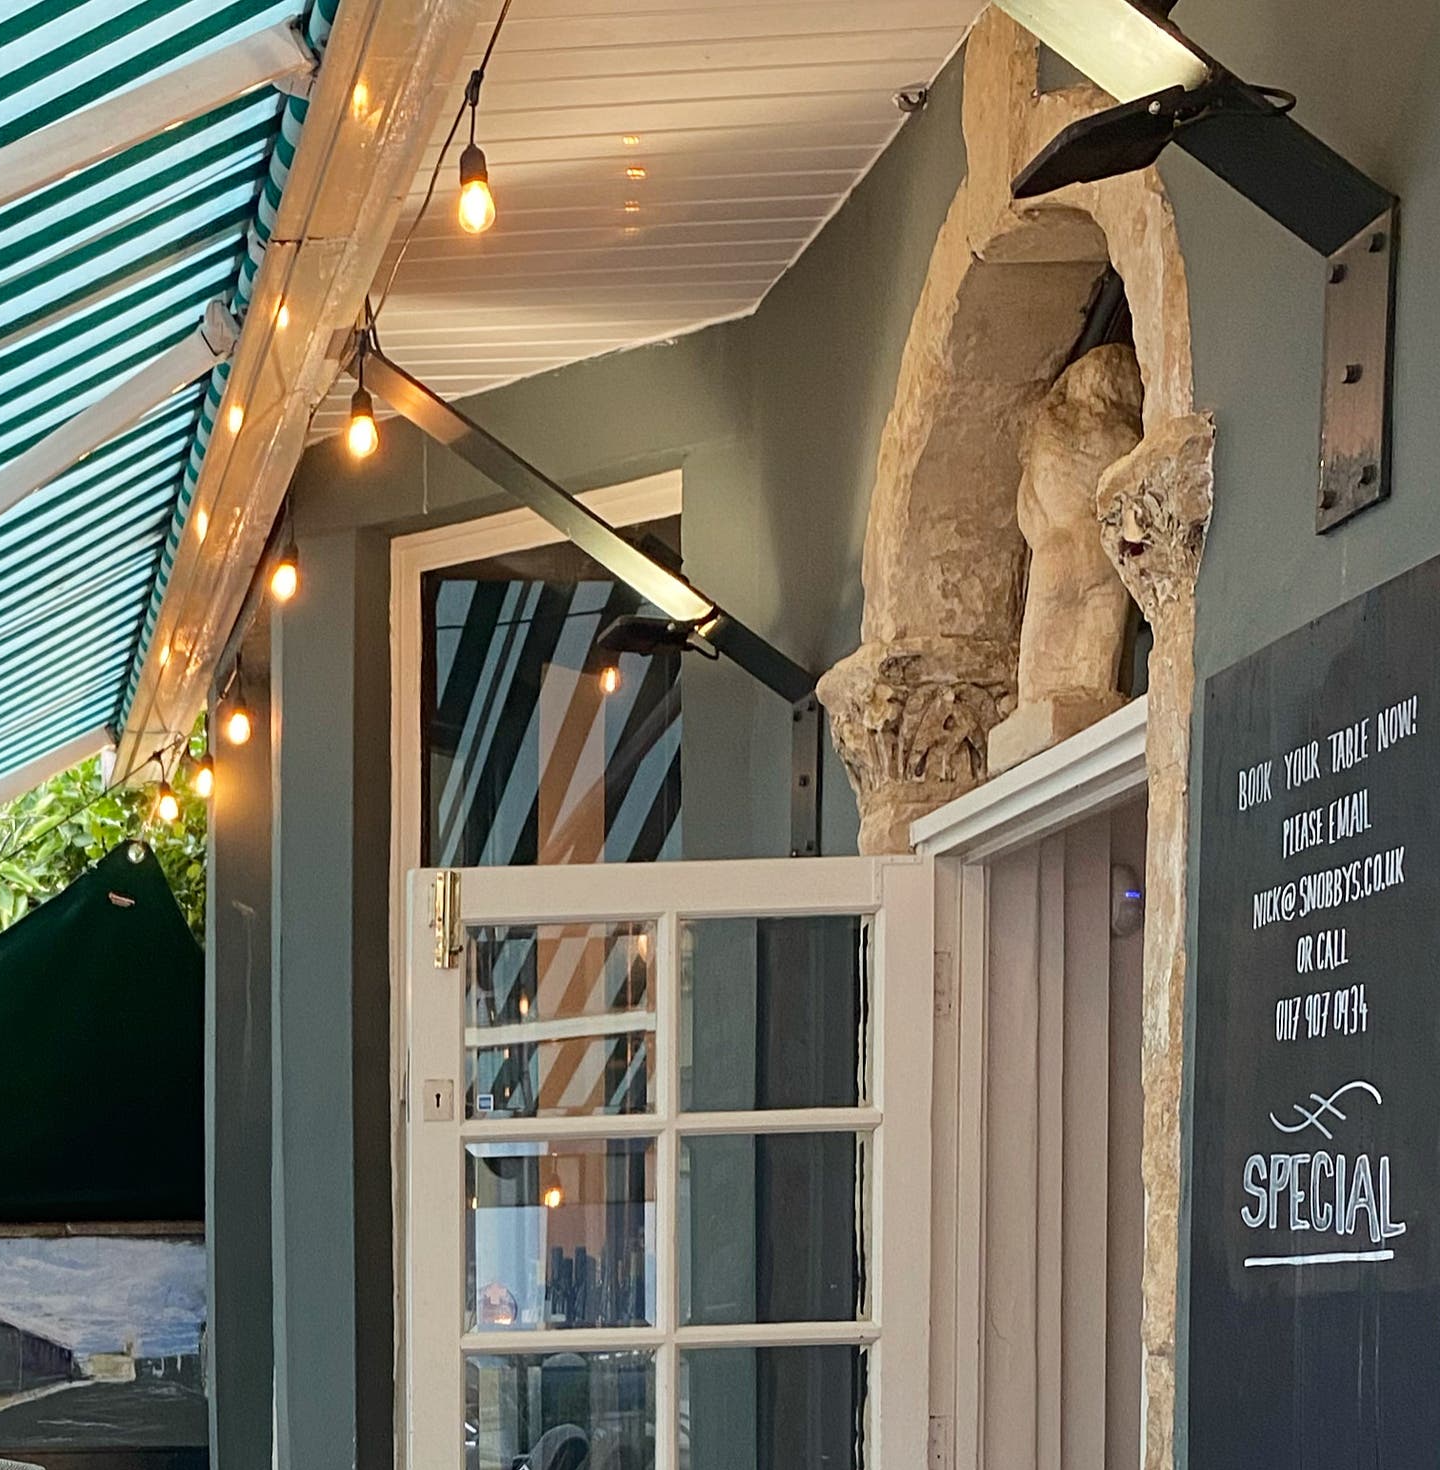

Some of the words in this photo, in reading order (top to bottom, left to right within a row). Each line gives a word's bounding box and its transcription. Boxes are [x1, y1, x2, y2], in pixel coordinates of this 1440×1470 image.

[1238, 760, 1272, 812] BOOK
[1284, 740, 1320, 790] YOUR
[1327, 717, 1370, 774] TABLE
[1377, 695, 1417, 752] NOW!
[1282, 807, 1324, 859] PLEASE
[1328, 788, 1372, 844] EMAIL
[1296, 935, 1314, 974] OR
[1316, 928, 1349, 970] CALL
[1275, 996, 1301, 1041] 0117
[1305, 991, 1330, 1039] 907
[1333, 983, 1368, 1036] 0934
[1241, 1151, 1407, 1243] SPECIAL
